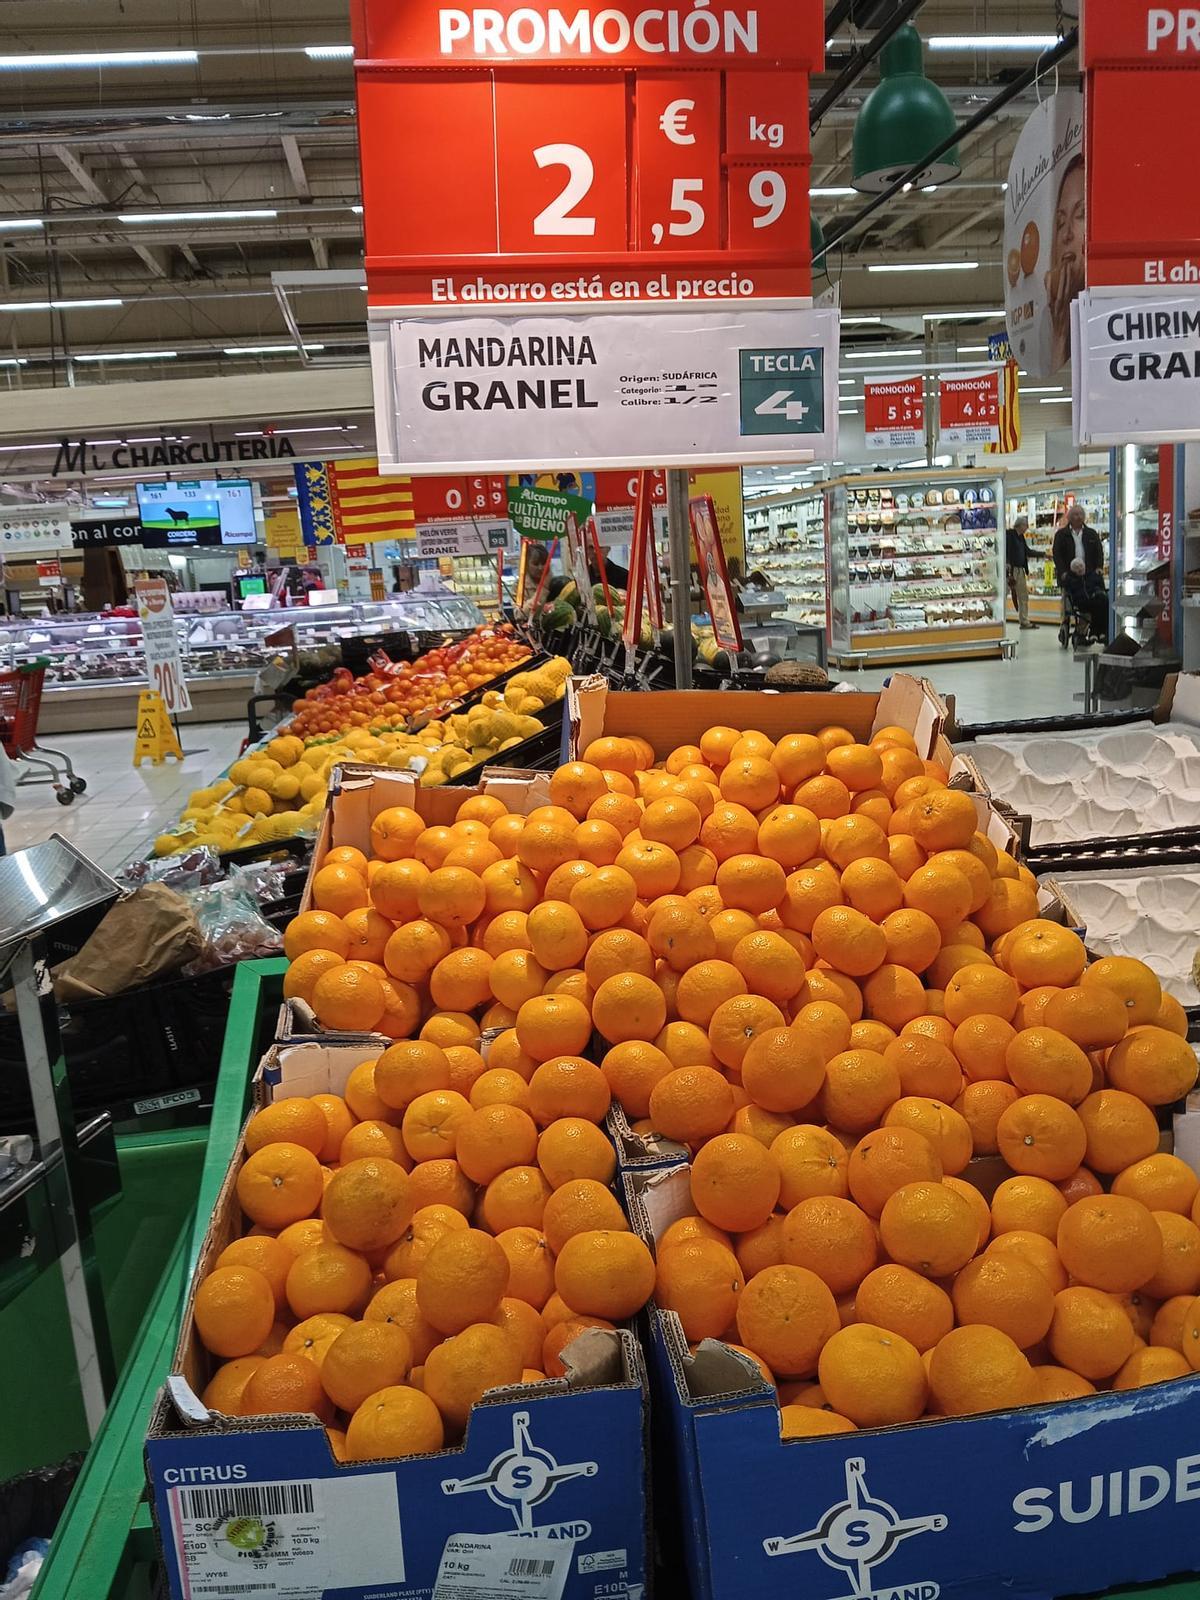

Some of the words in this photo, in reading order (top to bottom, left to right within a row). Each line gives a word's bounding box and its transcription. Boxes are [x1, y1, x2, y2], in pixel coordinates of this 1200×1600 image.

[438, 0, 758, 53] PROMOCIÓN
[1147, 8, 1200, 51] PR
[659, 99, 696, 145] €
[749, 116, 784, 148] kg
[532, 143, 596, 236] 2
[1144, 260, 1166, 282] El
[1170, 260, 1200, 282] ah
[431, 278, 456, 301] El
[460, 277, 546, 300] ahorro
[551, 274, 603, 299] está
[610, 280, 640, 298] en
[646, 274, 669, 297] el
[676, 271, 754, 301] precio
[1107, 311, 1200, 341] CHIRIM
[418, 335, 598, 368] MANDARINA
[750, 354, 815, 372] TECLA
[619, 374, 660, 384] Origen:
[662, 371, 717, 381] SUDÁFRICA
[946, 380, 991, 391] PROMOCIÓN
[422, 378, 599, 411] GRANEL
[870, 383, 916, 395] PROMOCIÓN
[620, 398, 662, 406] Calibre:
[754, 390, 810, 420] 4
[51, 438, 105, 477] Mi
[112, 438, 296, 469] CHARCUTERÍA
[520, 489, 568, 506] Alcampo
[94, 524, 107, 539] al
[113, 525, 141, 538] cor
[522, 516, 566, 533] BUENO
[422, 547, 459, 555] GRANEL
[162, 1093, 185, 1105] IFCO
[163, 1464, 247, 1483] CITRUS
[586, 1466, 593, 1474] E
[850, 1462, 859, 1472] N
[511, 1466, 532, 1489] S
[445, 1484, 456, 1492] W
[1012, 1453, 1200, 1533] SUIDE
[933, 1518, 942, 1527] E
[845, 1520, 870, 1547] S
[768, 1541, 779, 1552] W
[443, 1561, 455, 1569] 10
[458, 1562, 470, 1572] kg
[594, 1581, 629, 1595] E10D
